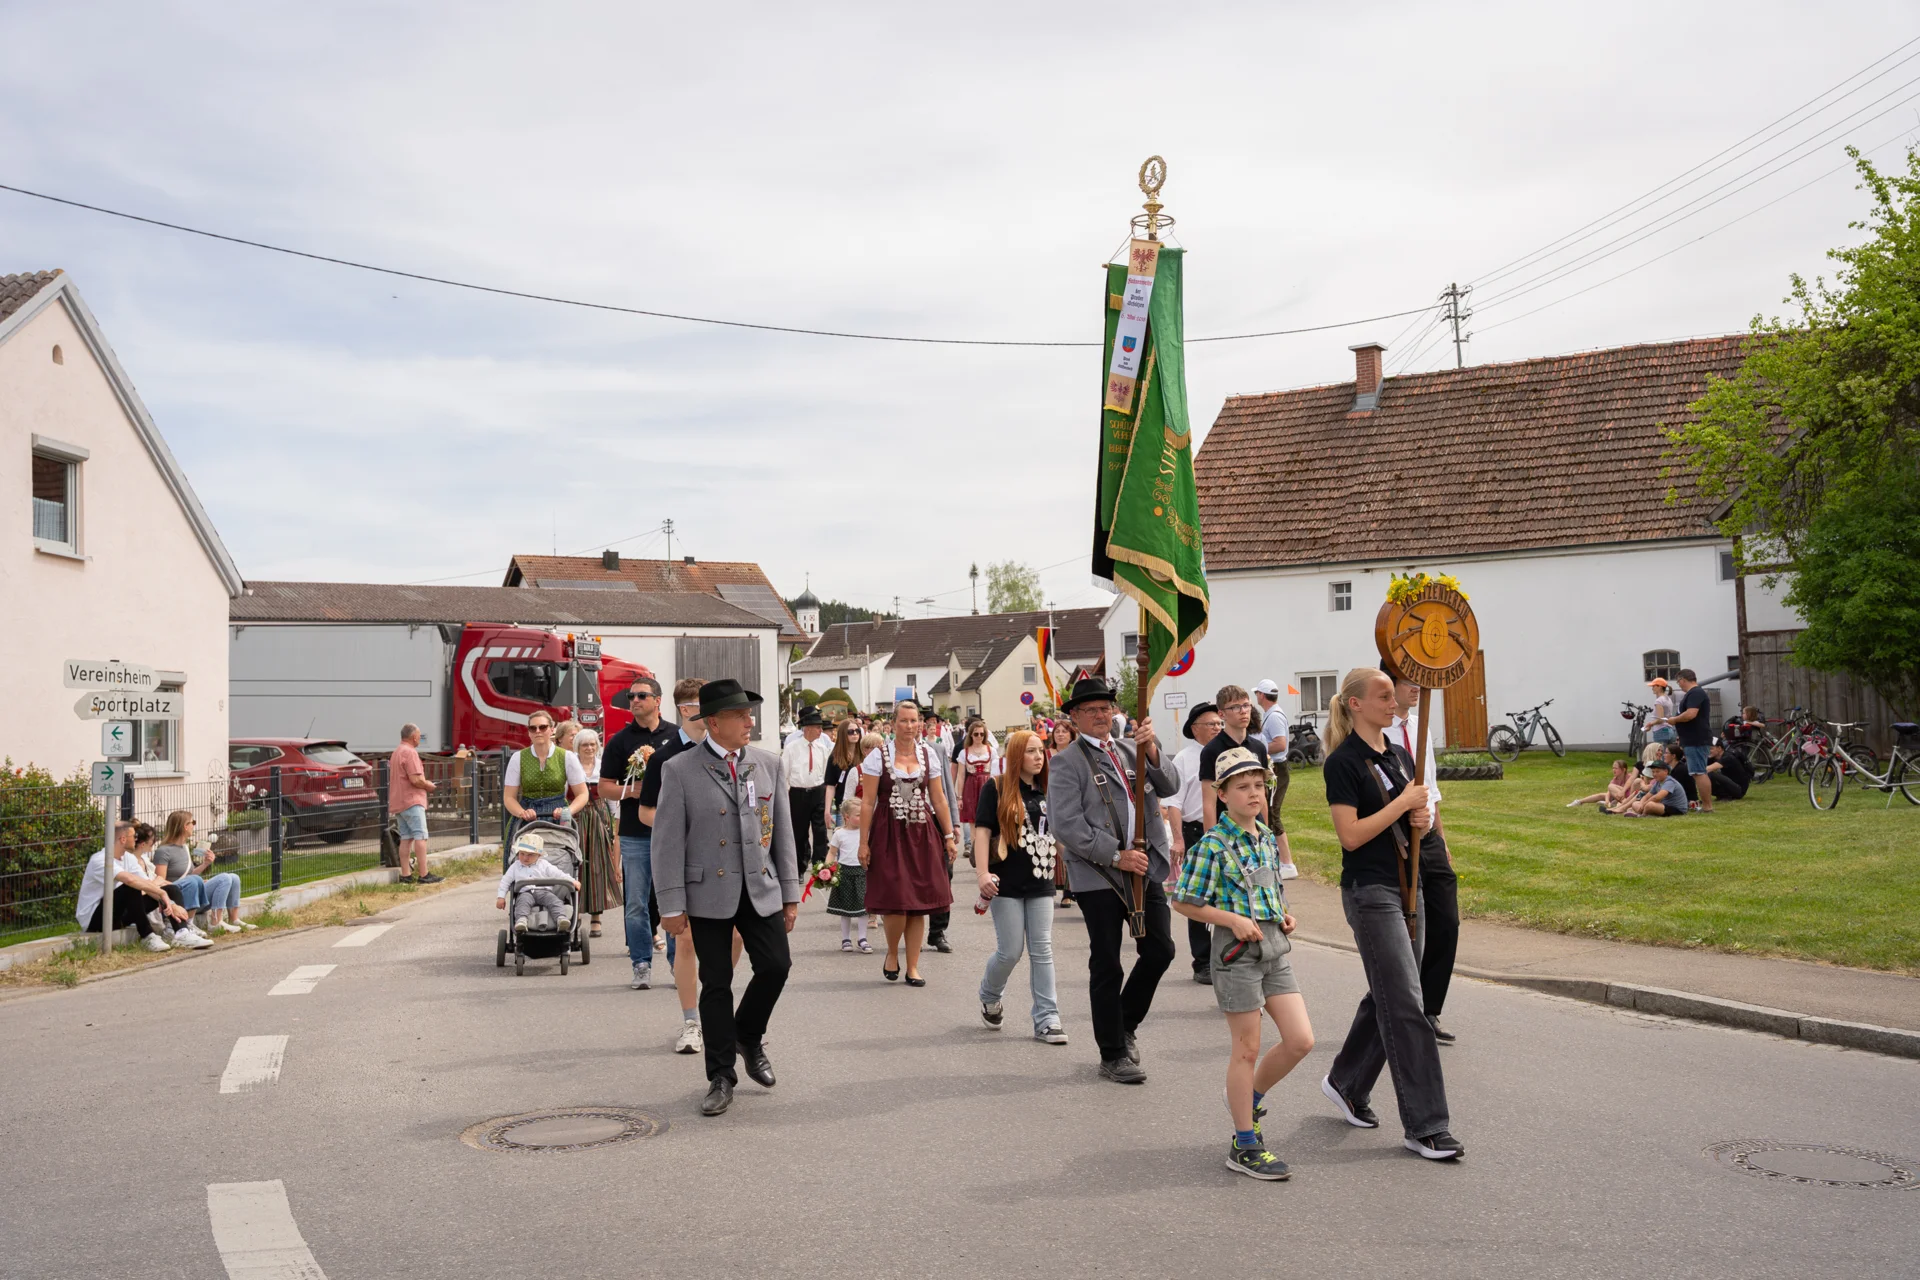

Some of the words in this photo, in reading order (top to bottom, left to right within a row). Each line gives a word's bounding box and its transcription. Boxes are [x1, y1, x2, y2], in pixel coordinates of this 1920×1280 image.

[70, 664, 151, 685] Vereinsheim
[1400, 655, 1465, 687] BIBERACH-ASCH
[92, 696, 170, 716] Sportplatz
